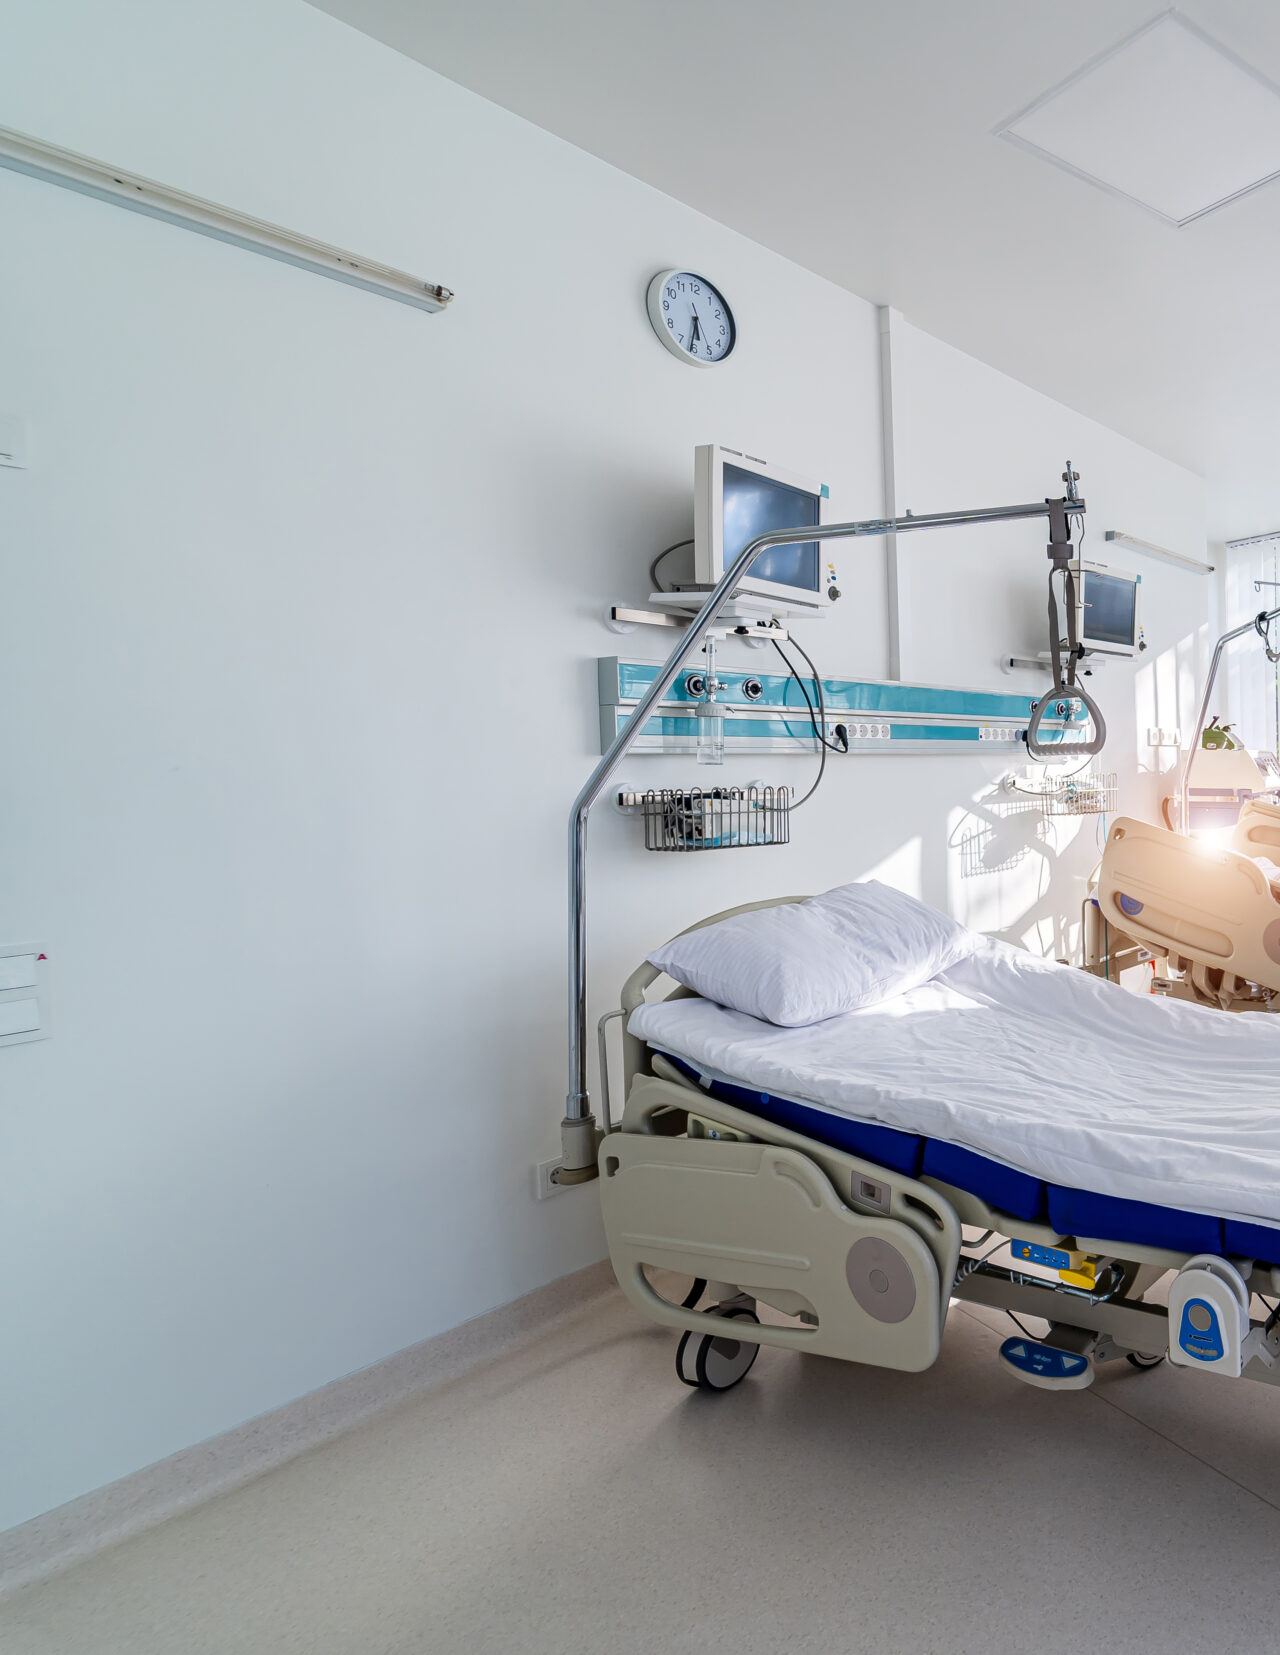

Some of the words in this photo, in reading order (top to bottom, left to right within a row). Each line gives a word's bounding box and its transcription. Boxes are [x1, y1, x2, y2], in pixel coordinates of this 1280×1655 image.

[677, 281, 684, 292] 11
[689, 283, 700, 295] 12
[666, 287, 677, 299] 10
[663, 300, 670, 310] 9
[715, 309, 721, 320] 2
[667, 318, 674, 328] 8
[720, 325, 725, 335] 3
[678, 334, 684, 343] 7
[715, 339, 721, 348] 4
[707, 346, 712, 355] 5
